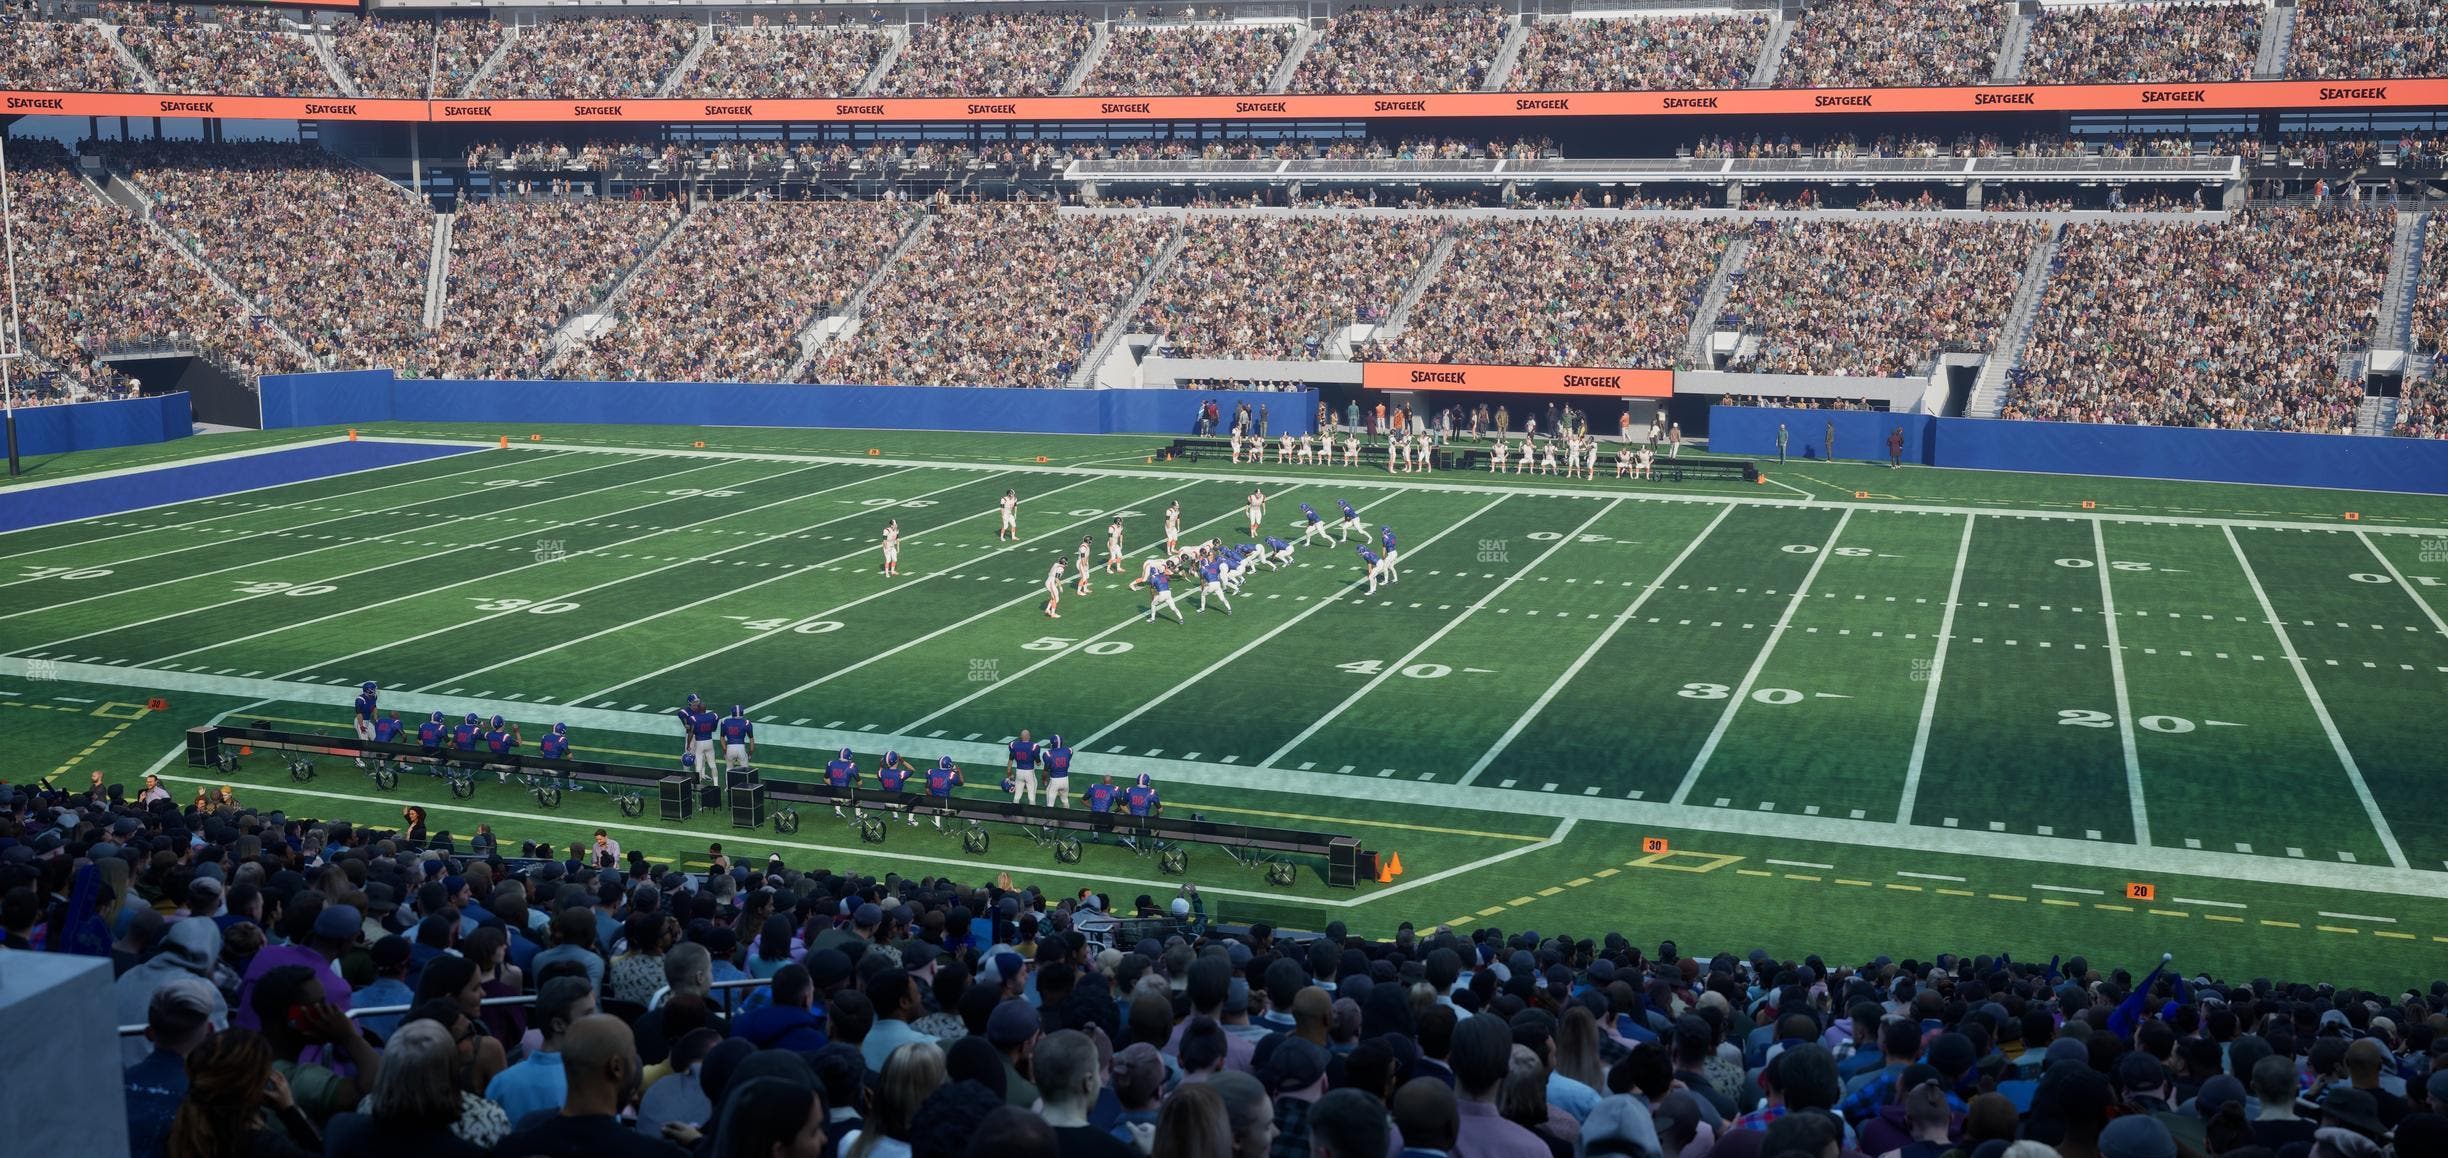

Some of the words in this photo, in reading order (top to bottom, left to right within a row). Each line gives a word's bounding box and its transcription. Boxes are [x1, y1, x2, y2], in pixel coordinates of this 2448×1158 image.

[1975, 92, 2034, 105] SEATGEEK
[2142, 90, 2205, 103] SEATGEEK
[2320, 87, 2387, 101] SEATGEEK
[7, 97, 63, 109] SEATGEEK
[160, 101, 214, 113] SEATGEEK
[1236, 102, 1286, 112] SEATGEEK
[1374, 101, 1425, 111] SEATGEEK
[1516, 99, 1568, 110] SEATGEEK
[1663, 97, 1717, 108] SEATGEEK
[1815, 95, 1872, 107] SEATGEEK
[306, 104, 357, 115] SEATGEEK
[446, 106, 491, 116] SEATGEEK
[575, 105, 622, 115] SEATGEEK
[705, 105, 752, 115] SEATGEEK
[836, 105, 884, 115] SEATGEEK
[968, 104, 1016, 114] SEATGEEK
[1101, 103, 1149, 113] SEATGEEK
[1411, 371, 1466, 385] SEATGEEK
[1564, 375, 1621, 389] SEATGEEK
[474, 598, 581, 615] 30
[741, 616, 845, 634] 40
[1020, 636, 1134, 656] 50
[1334, 659, 1453, 679] 40
[1676, 682, 1804, 705] 30
[2056, 709, 2196, 734] 20
[1649, 840, 1661, 851] 30
[2134, 885, 2147, 897] 20
